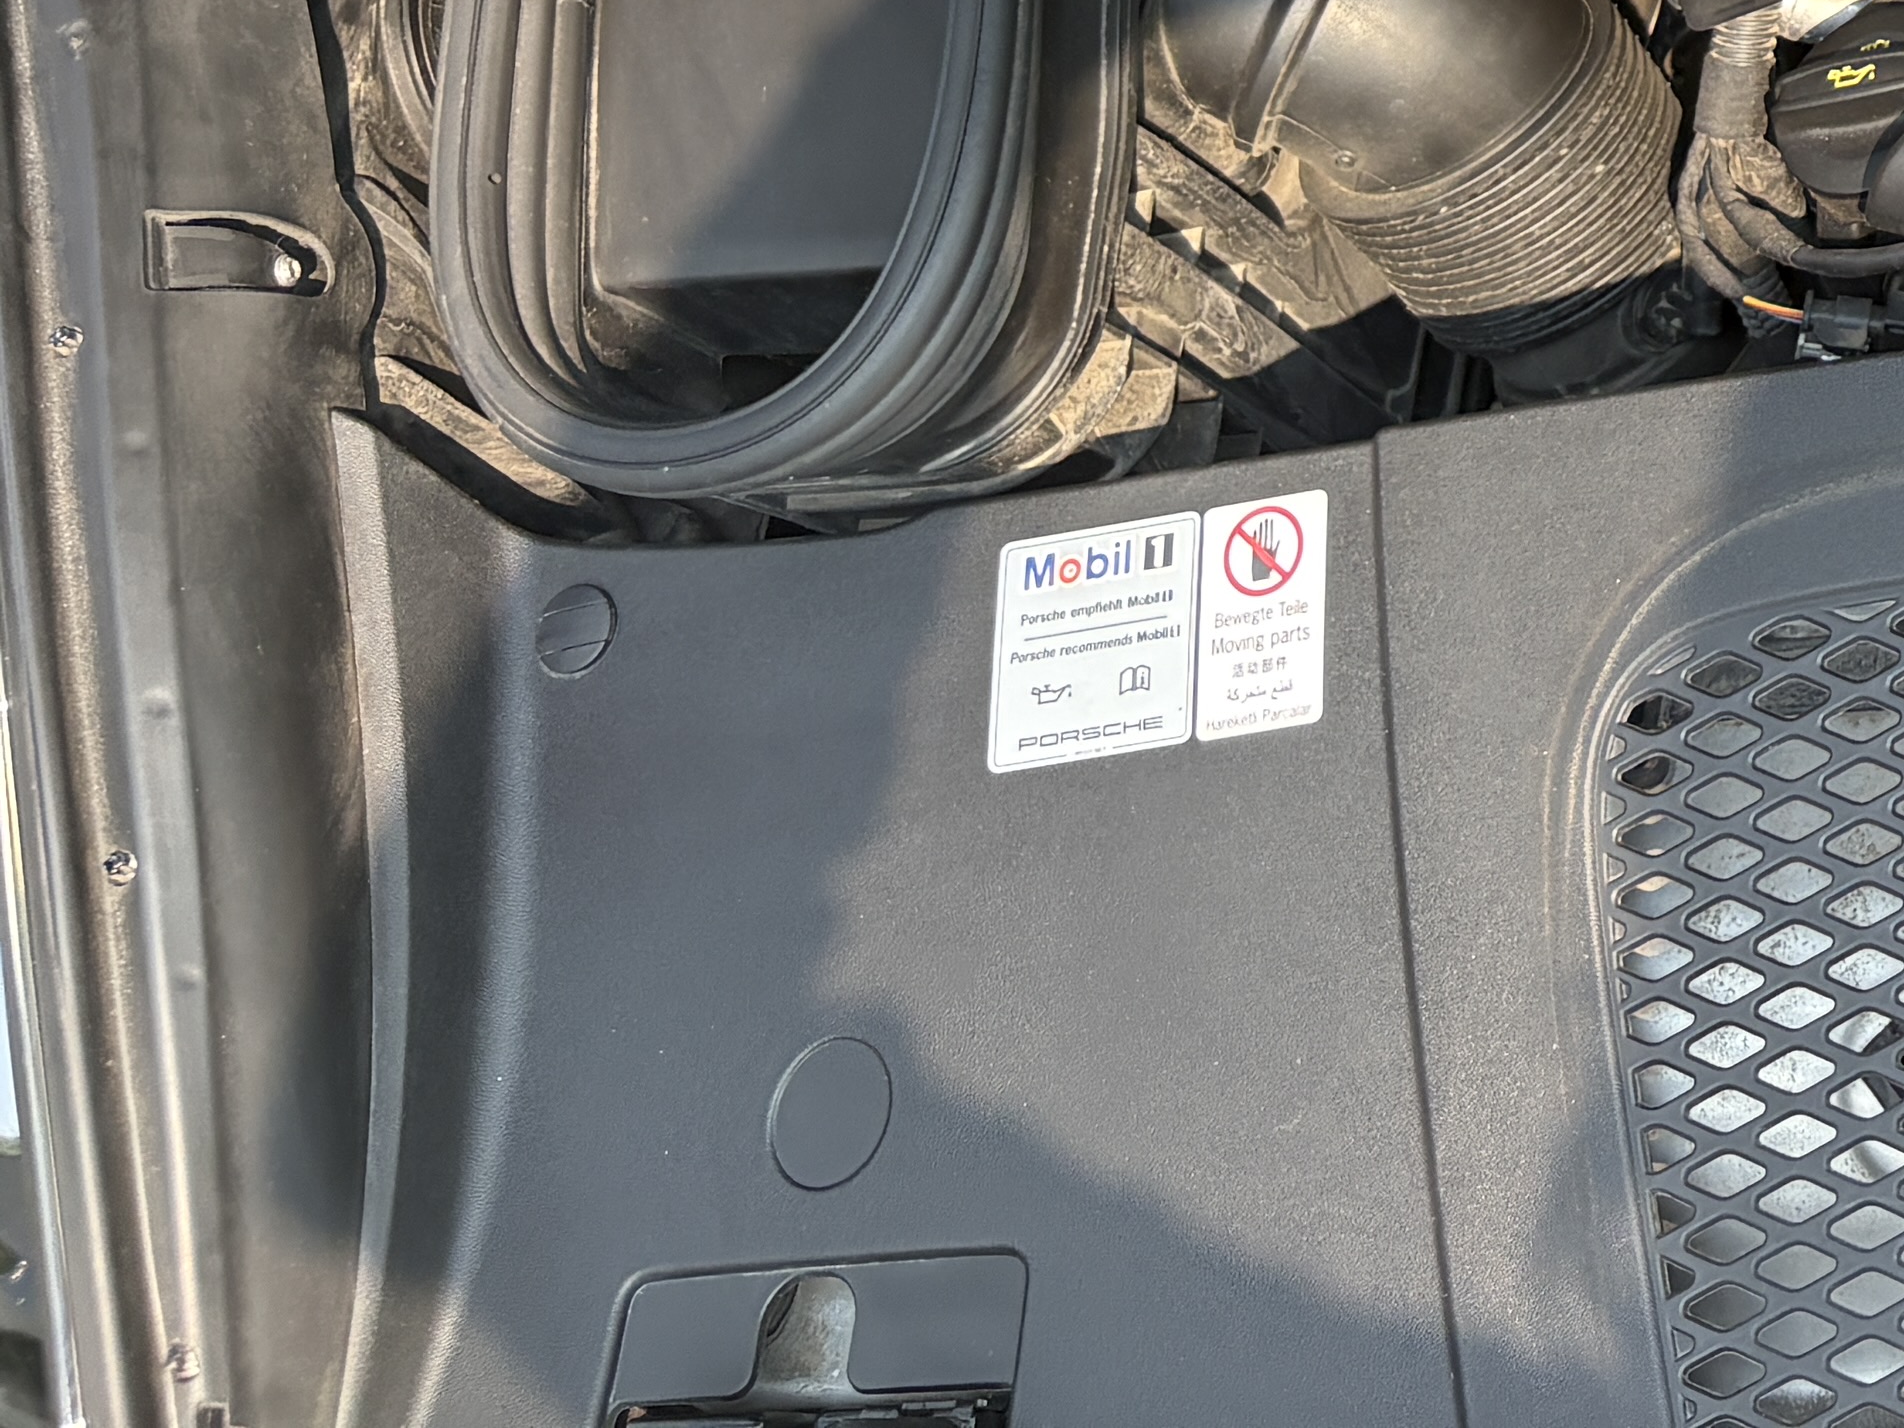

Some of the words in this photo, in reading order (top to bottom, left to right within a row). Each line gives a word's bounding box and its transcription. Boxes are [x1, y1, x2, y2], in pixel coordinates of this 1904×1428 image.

[1023, 539, 1132, 591] Mobil
[1144, 532, 1175, 571] 1
[1020, 609, 1066, 627] Porsche
[1071, 599, 1123, 618] empfiehlt
[1214, 607, 1274, 629] Bewegte
[1010, 646, 1056, 664] Porsche
[1060, 633, 1133, 657] recommends
[1137, 626, 1168, 643] Mobil
[1211, 635, 1265, 656] Moving
[1271, 626, 1310, 649] parts
[1018, 715, 1164, 751] PORSCHE
